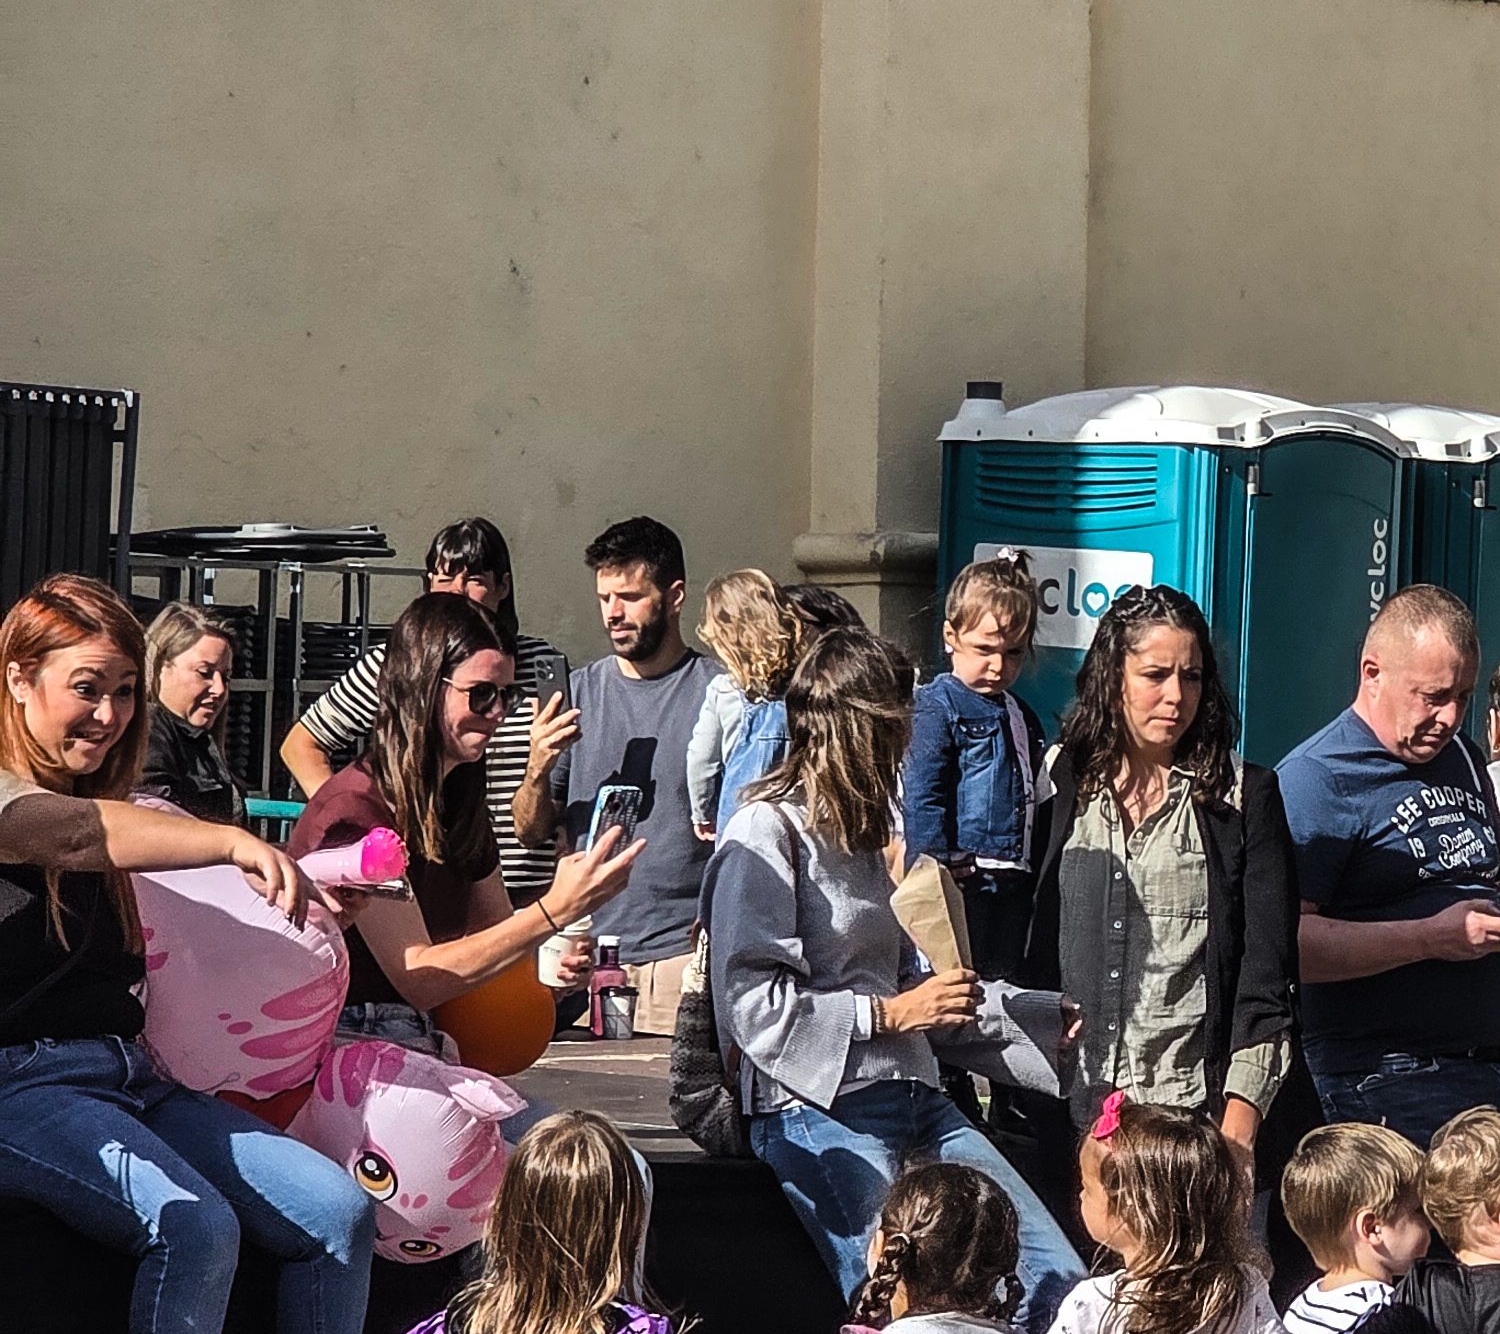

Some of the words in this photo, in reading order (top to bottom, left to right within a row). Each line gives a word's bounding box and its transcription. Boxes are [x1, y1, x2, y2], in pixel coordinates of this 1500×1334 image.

[1035, 568, 1132, 618] clo
[1391, 796, 1423, 834] LEE
[1420, 786, 1487, 819] COOPER
[1408, 837, 1426, 858] 19
[1438, 827, 1475, 854] Denim
[1438, 838, 1486, 869] Company
